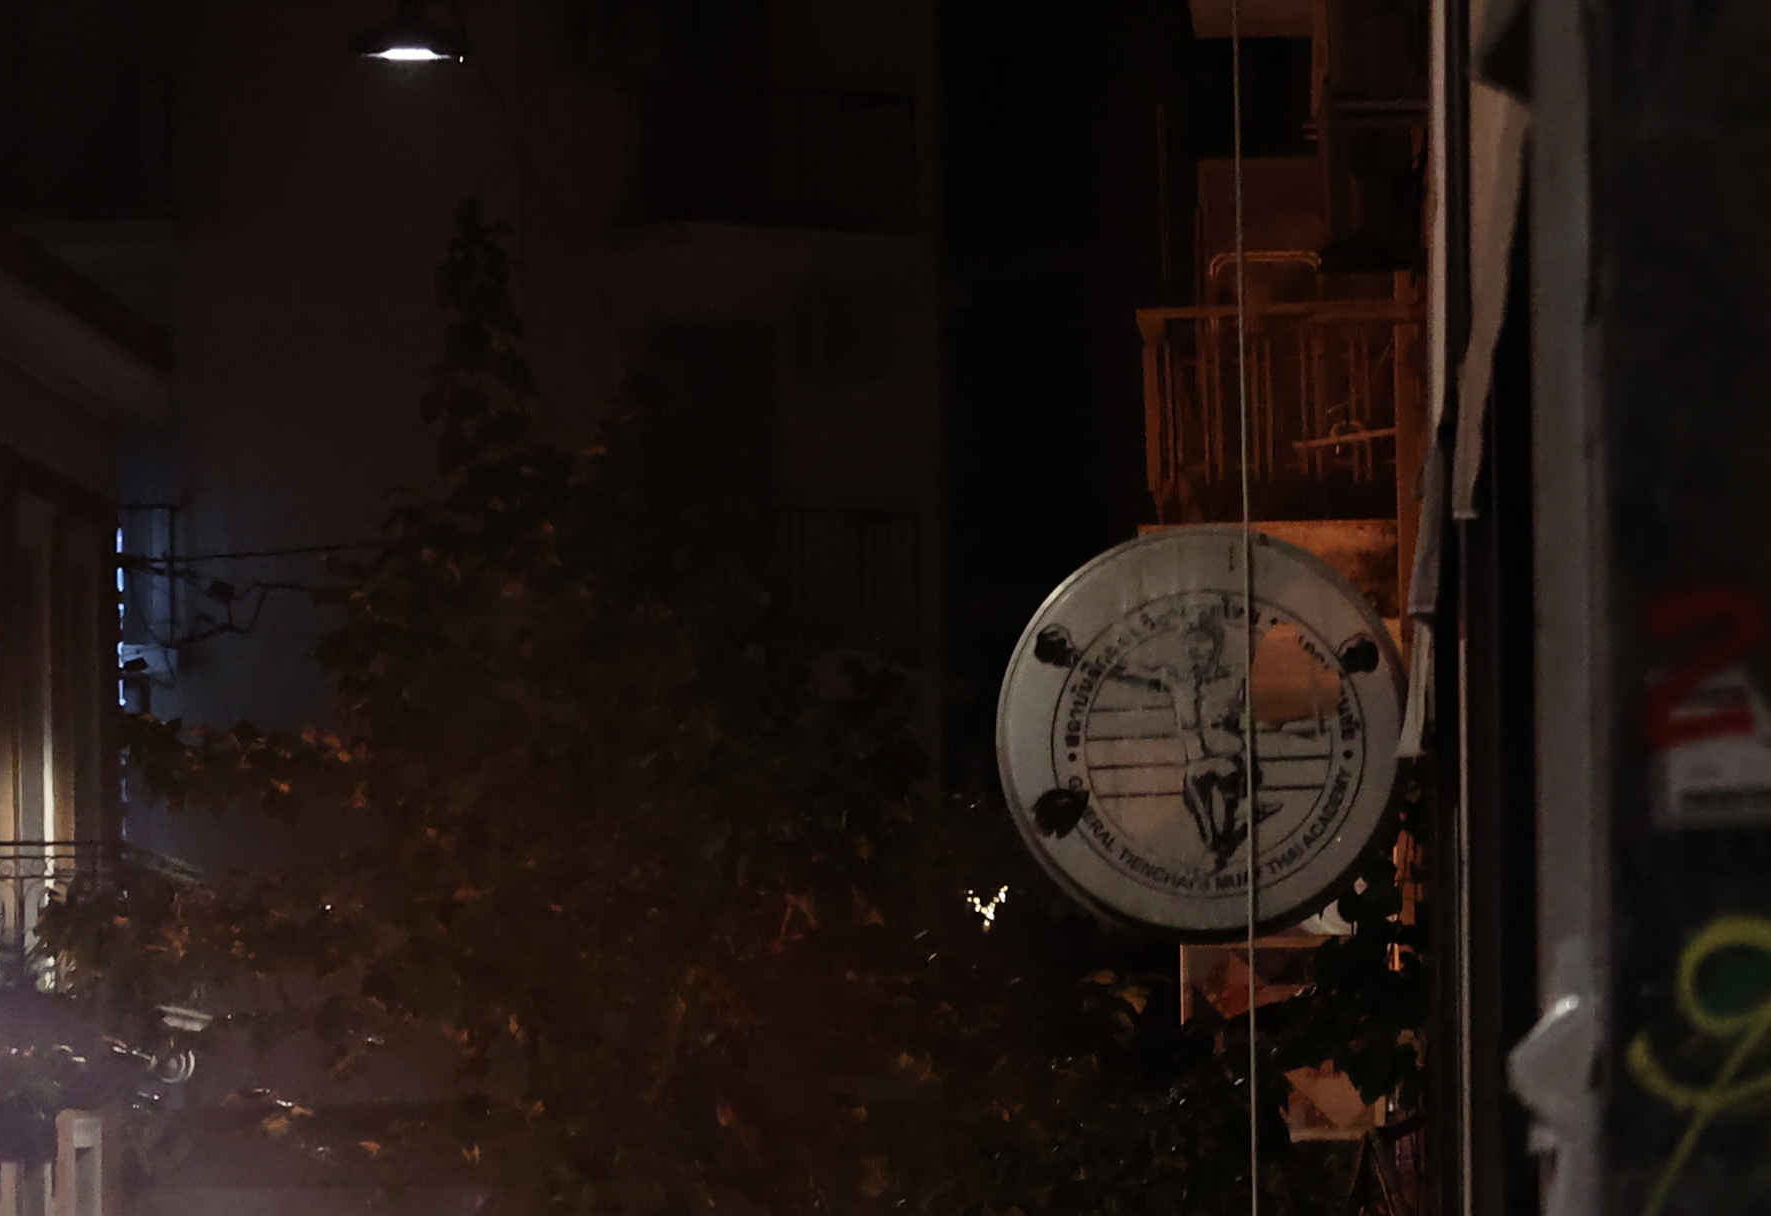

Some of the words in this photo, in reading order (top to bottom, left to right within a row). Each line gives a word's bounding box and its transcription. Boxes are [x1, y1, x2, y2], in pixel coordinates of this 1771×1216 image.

[1068, 775, 1115, 854] GERAL
[1269, 847, 1304, 875] THAI
[1301, 768, 1352, 848] ACADEMY
